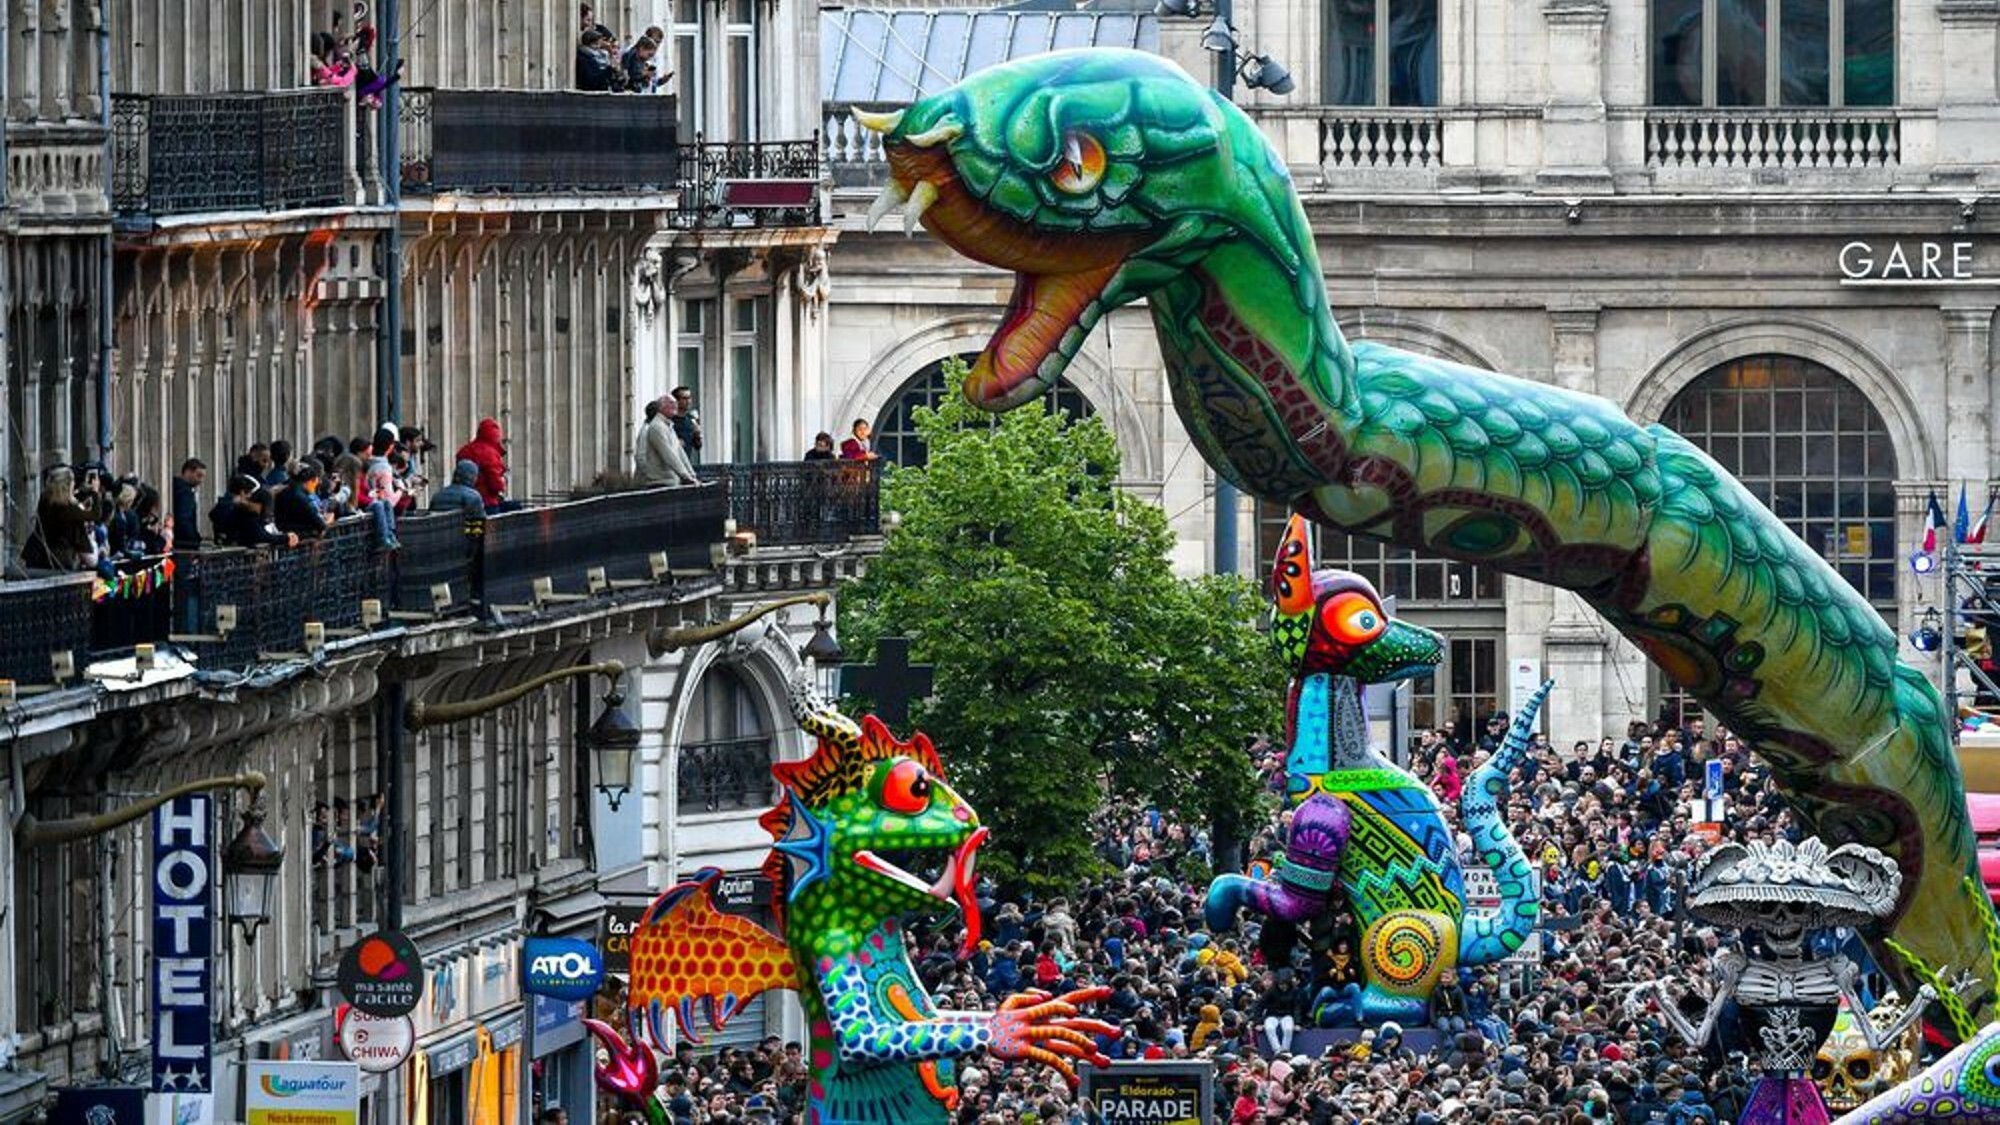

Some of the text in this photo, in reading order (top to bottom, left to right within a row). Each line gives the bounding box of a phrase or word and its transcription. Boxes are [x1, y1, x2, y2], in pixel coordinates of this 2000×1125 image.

[1838, 240, 1973, 278] GARE
[157, 799, 208, 1058] HOTEL
[530, 952, 597, 978] ATOL
[355, 983, 375, 992] ma
[352, 1046, 401, 1059] CHIWA
[1120, 1085, 1175, 1096] Eldorado
[1102, 1100, 1192, 1118] PARADE
[267, 1112, 337, 1125] Neckermann
